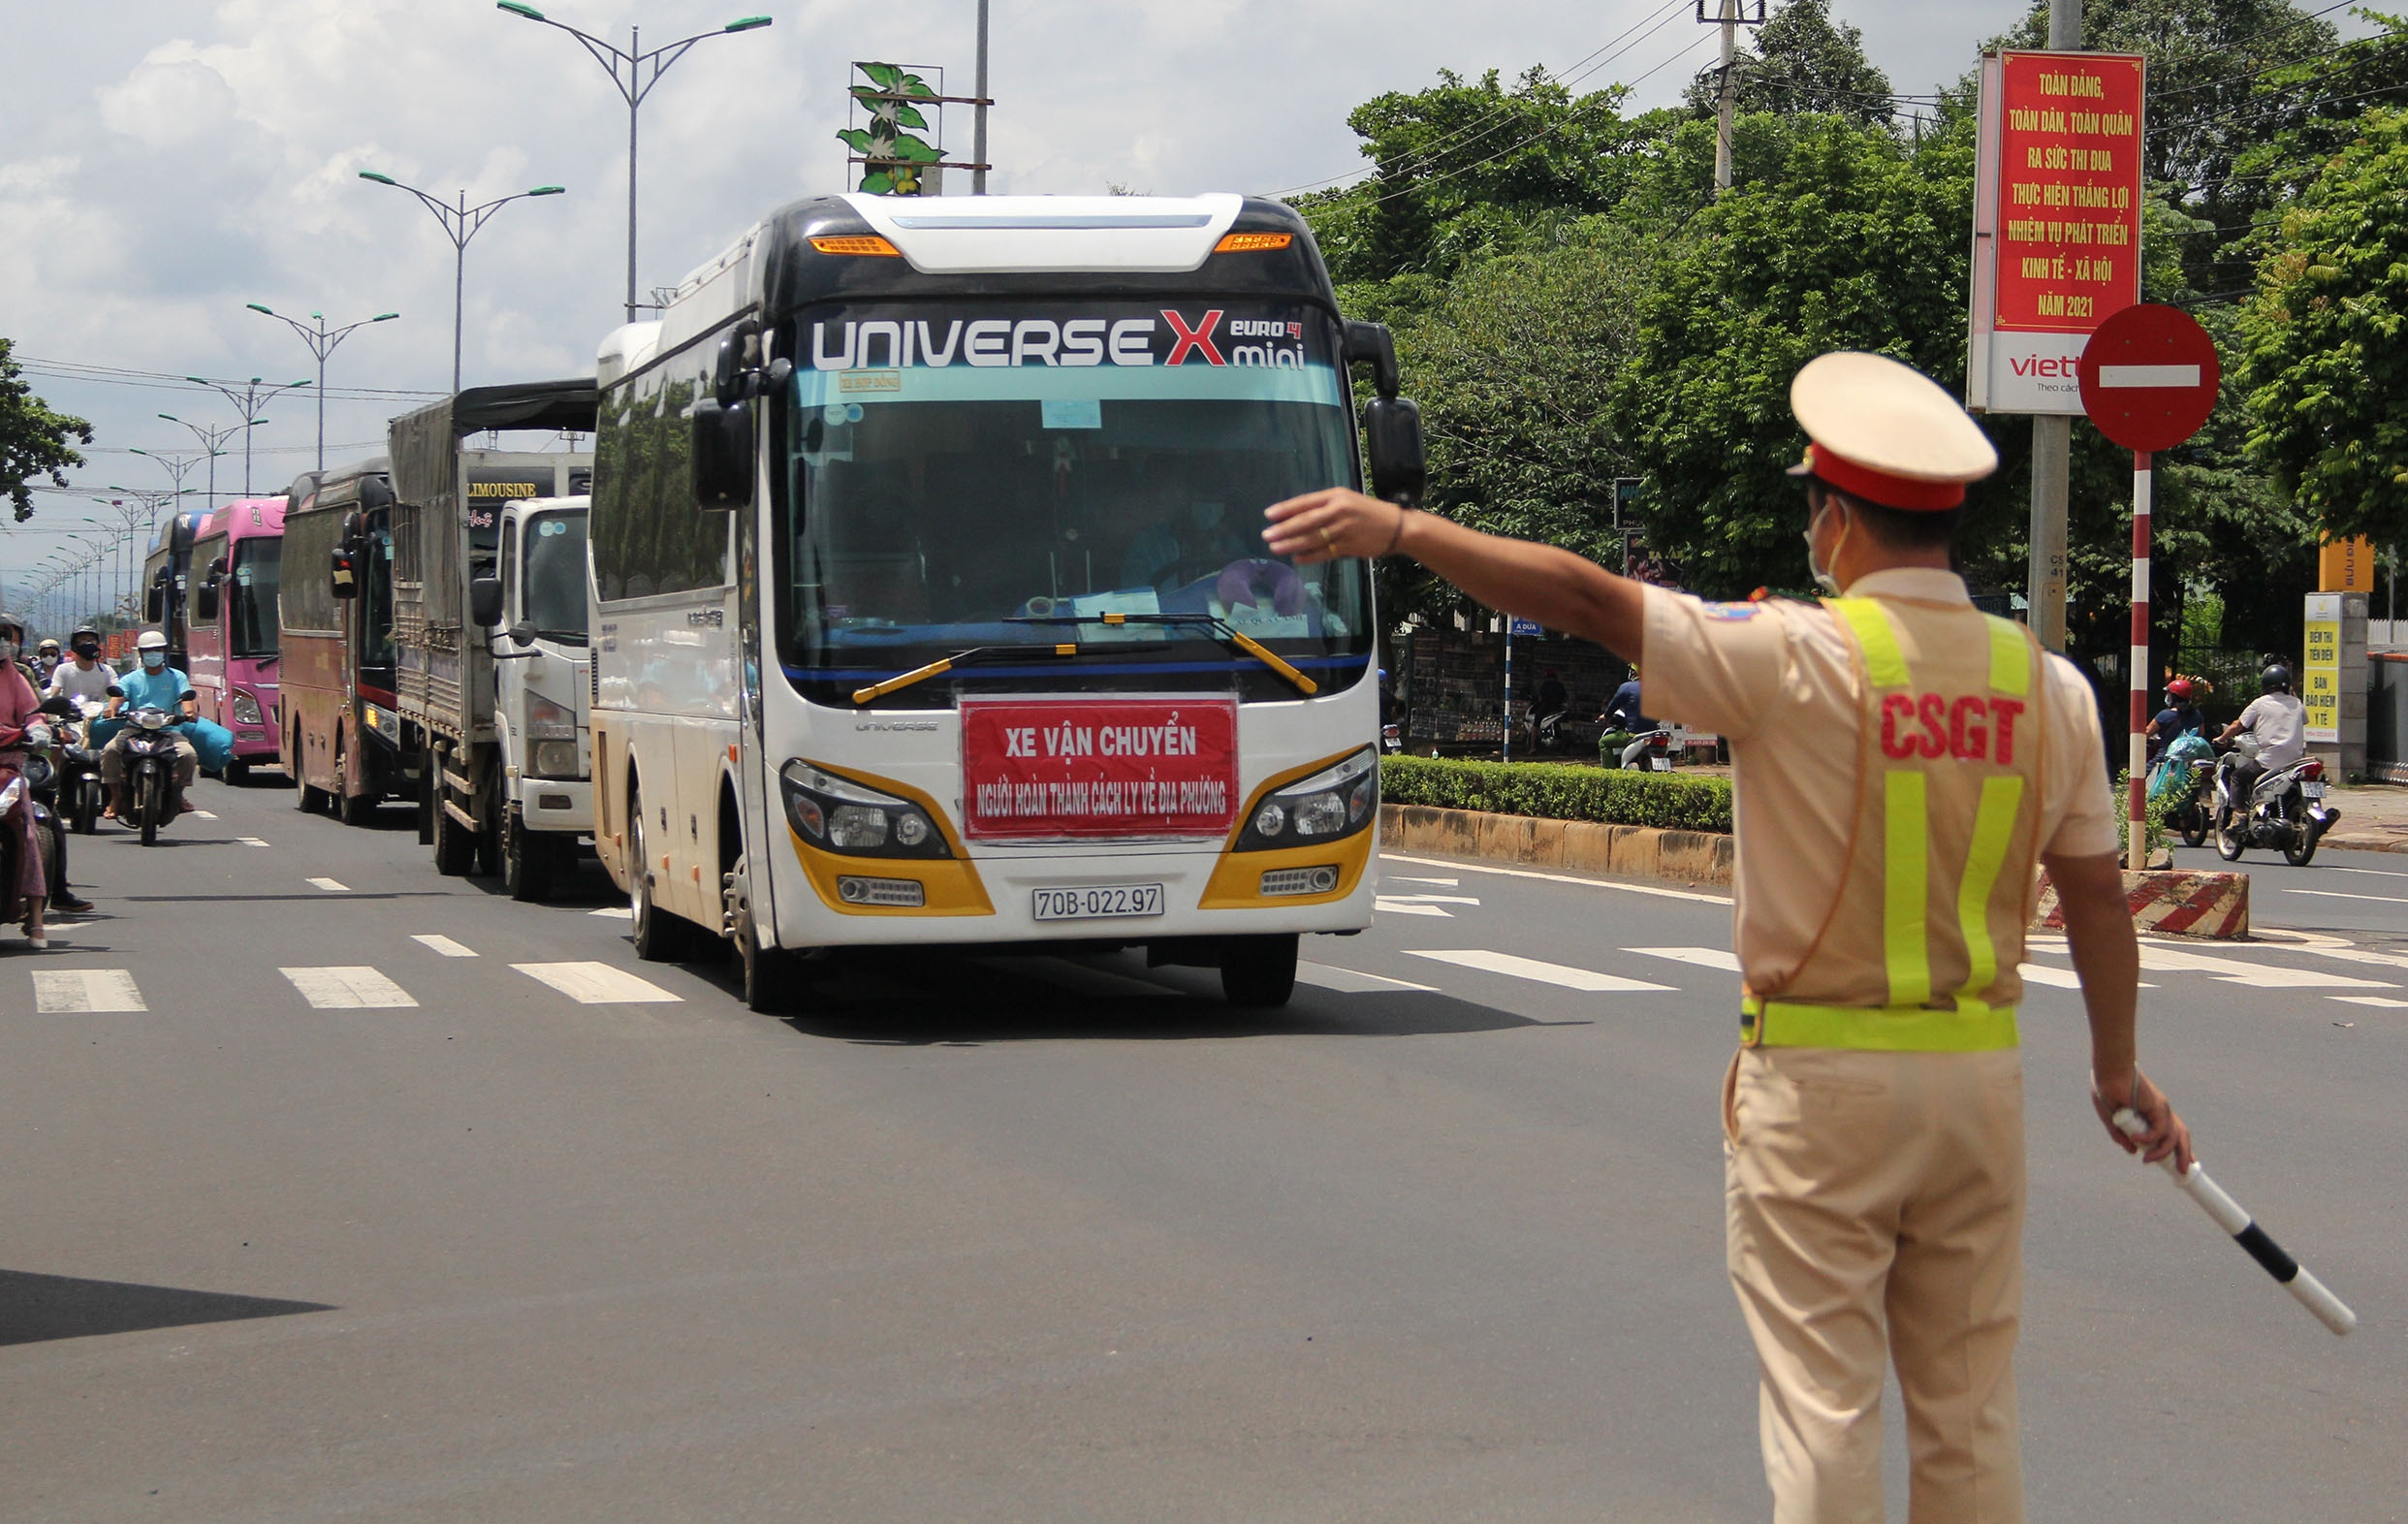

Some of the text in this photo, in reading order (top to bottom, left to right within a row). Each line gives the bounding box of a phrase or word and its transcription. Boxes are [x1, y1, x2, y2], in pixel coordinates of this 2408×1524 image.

[2039, 68, 2105, 101] TOÀN ĐẢNG,
[2009, 105, 2133, 138] TOÀN DÂN, TOÀN QUÂN
[2027, 143, 2112, 172] RA SỨC THI ĐUA
[2012, 178, 2129, 213] THỰC HIỆN THẮNG LỢI
[2008, 215, 2128, 248] NHIỆM VỤ PHÁT TRIỂN
[2021, 257, 2049, 279] KINH
[2051, 252, 2067, 280] TẾ
[2075, 256, 2091, 280] XÃ
[2093, 256, 2112, 286] HỘI
[2038, 290, 2094, 317] NĂM 2021
[812, 309, 1228, 371] UNIVERSE X
[1285, 321, 1302, 339] 4
[1232, 341, 1305, 371] mini
[2010, 353, 2080, 378] viett
[2038, 382, 2059, 393] Theo
[467, 482, 536, 497] LIMOUSINE
[2050, 568, 2064, 578] 41
[855, 721, 938, 731] UNIVERSE
[1005, 711, 1196, 765] XE VẬN CHUYỂN
[1881, 692, 2025, 766] CSGT
[977, 774, 1012, 817] NGƯỜI
[1016, 774, 1047, 816] HOÀN
[1050, 773, 1089, 815] THÀNH
[1092, 772, 1122, 815] CÁCH
[1124, 781, 1139, 815] LY
[1141, 767, 1156, 815] VỀ
[1159, 781, 1178, 824] ĐỊA
[1038, 888, 1157, 916] 70B-022.97
